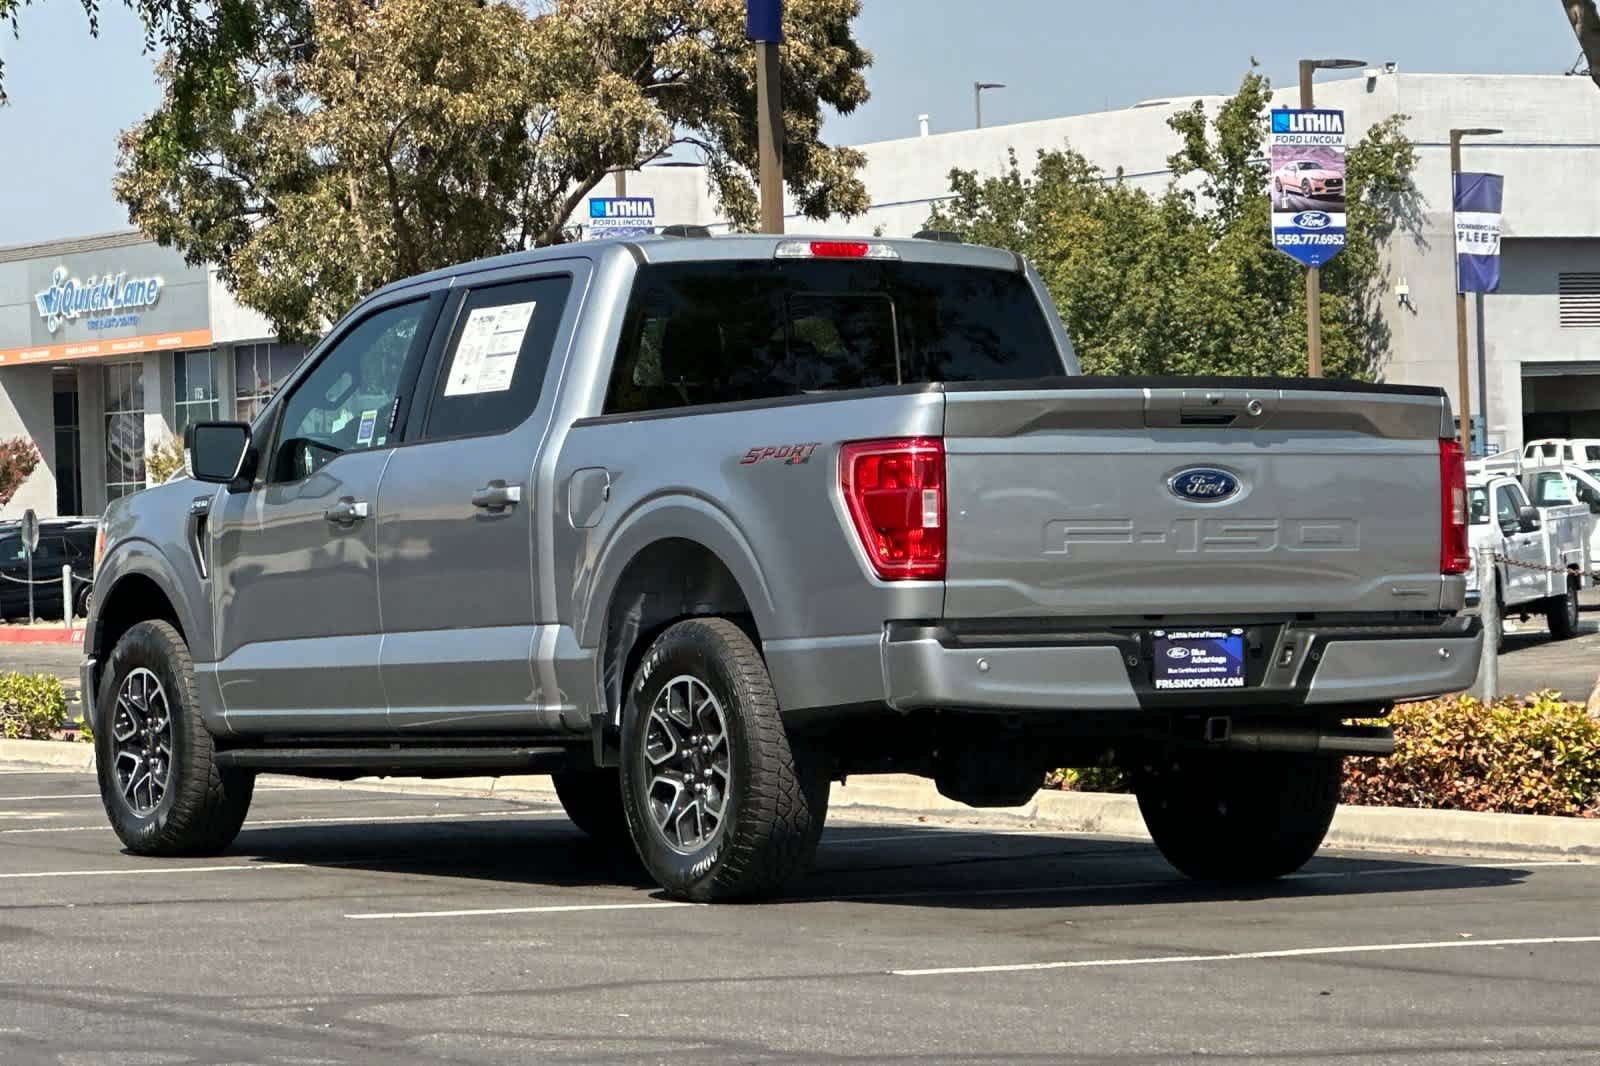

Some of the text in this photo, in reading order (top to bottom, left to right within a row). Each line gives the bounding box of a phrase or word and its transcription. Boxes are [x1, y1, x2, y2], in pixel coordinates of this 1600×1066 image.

[1289, 113, 1343, 132] LITHIA
[1275, 135, 1343, 144] FORD LINCOLN
[605, 201, 653, 217] LITHIA
[1301, 212, 1328, 227] Ford
[1458, 231, 1500, 243] FLEET
[61, 274, 159, 317] Quick Lane
[739, 442, 823, 465] SPORT
[1186, 474, 1226, 495] Ford
[1041, 517, 1361, 553] F-150
[1191, 656, 1227, 664] Advantage
[1155, 678, 1244, 689] FRESNOFORD.COM
